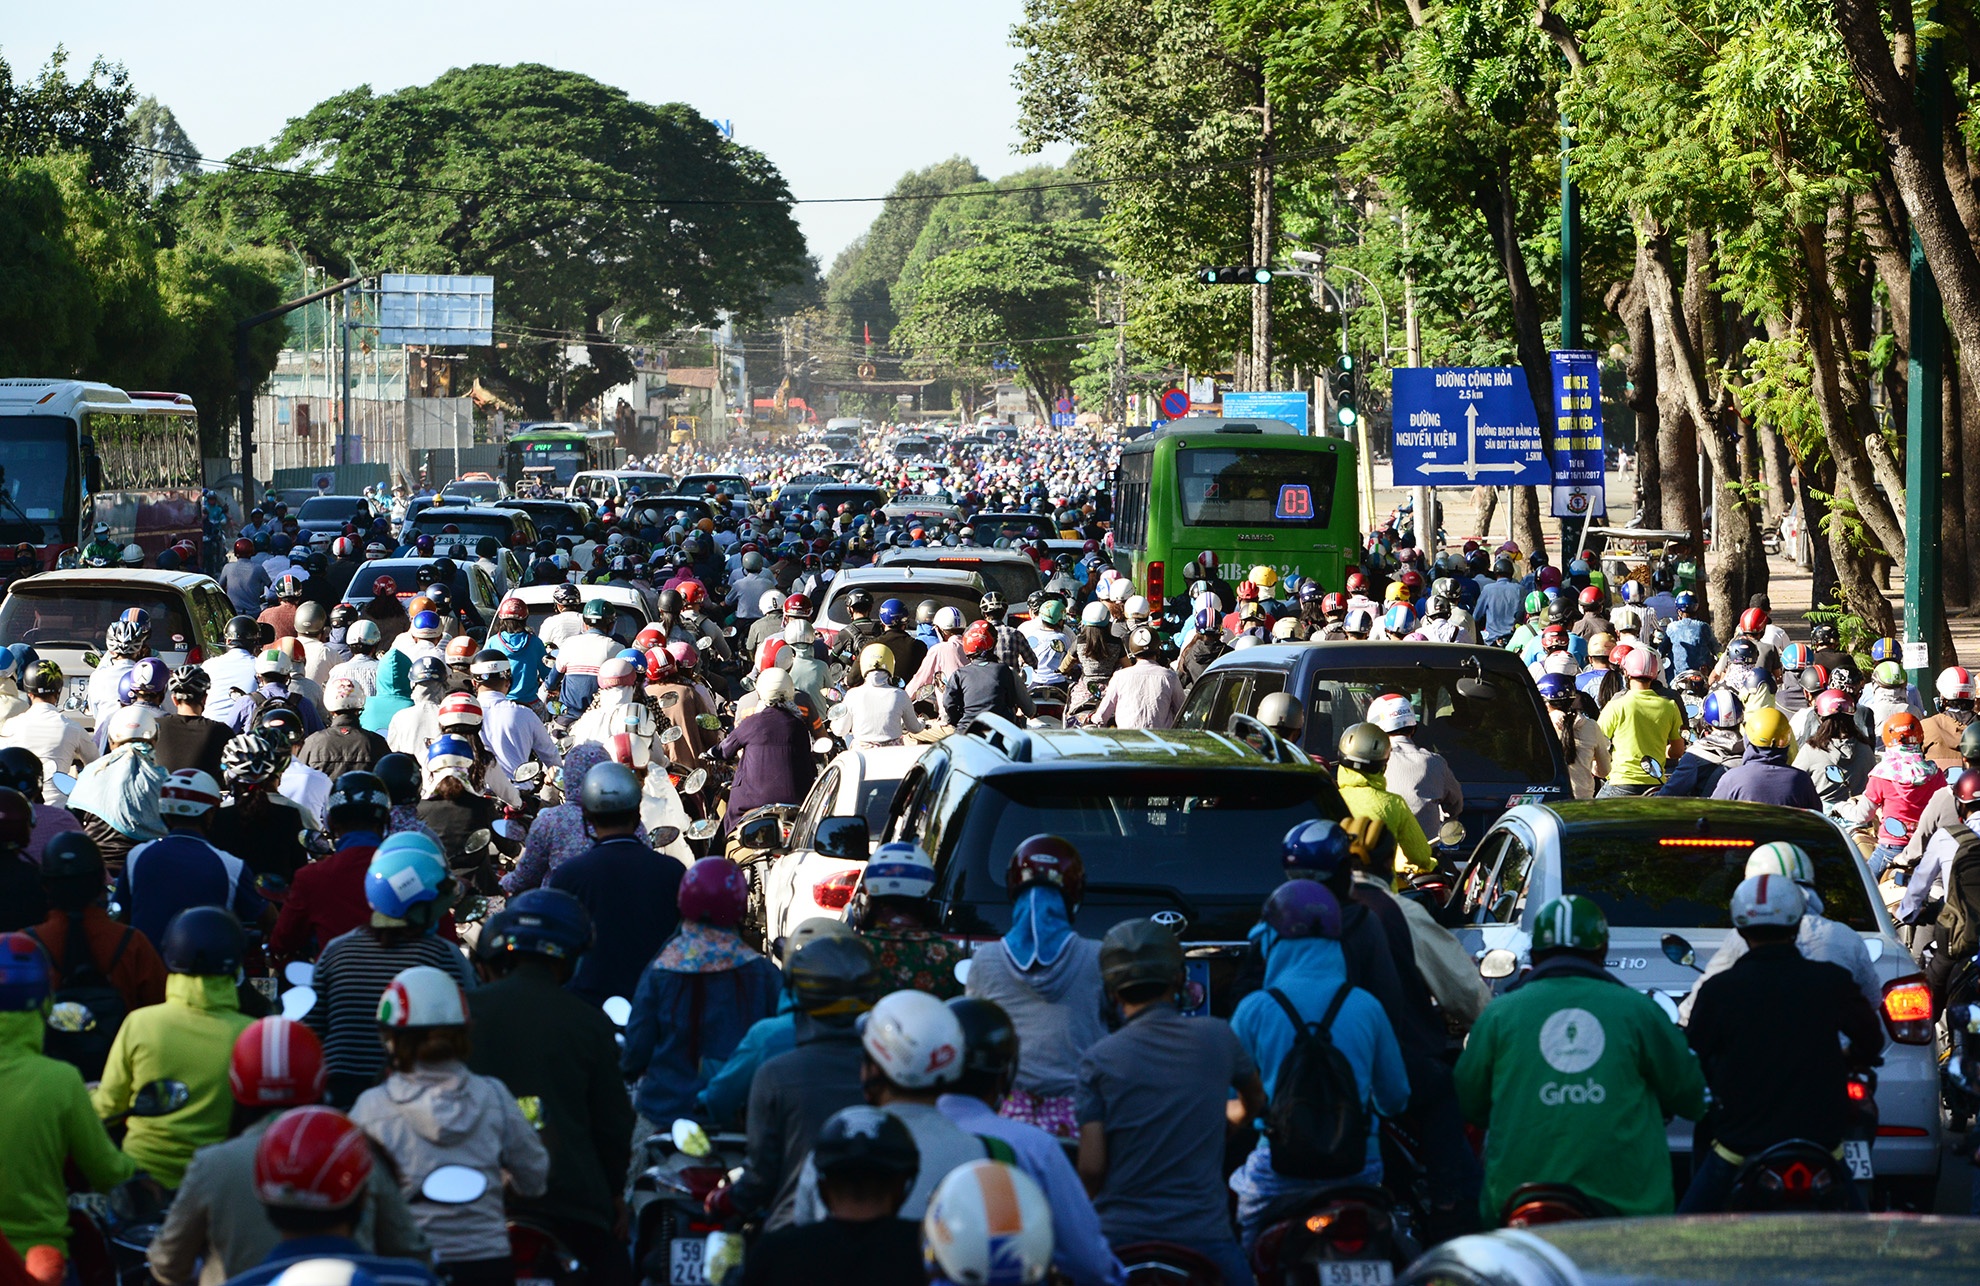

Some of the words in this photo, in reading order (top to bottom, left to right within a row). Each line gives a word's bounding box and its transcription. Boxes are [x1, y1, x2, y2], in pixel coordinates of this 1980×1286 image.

[1435, 370, 1466, 387] ĐƯỜNG
[1468, 369, 1492, 389] CỘNG
[1494, 369, 1513, 387] HÒA
[1458, 390, 1471, 399] 2.5
[1472, 390, 1484, 399] km
[1410, 409, 1441, 427] ĐƯỜNG
[1396, 428, 1431, 446] NGUYỄN
[1434, 429, 1457, 449] KIỆM
[1476, 423, 1497, 436] ĐƯỜNG
[1498, 427, 1515, 438] BẠCH
[1485, 438, 1496, 449] SÂN
[1497, 440, 1507, 449] BAY
[1508, 438, 1519, 449] TÂN
[1555, 470, 1569, 479] NGÀY
[1284, 489, 1308, 514] 03
[1525, 785, 1561, 793] ZACE
[1507, 795, 1544, 807] HTV
[1539, 1077, 1606, 1105] Grab
[682, 1242, 701, 1261] 59
